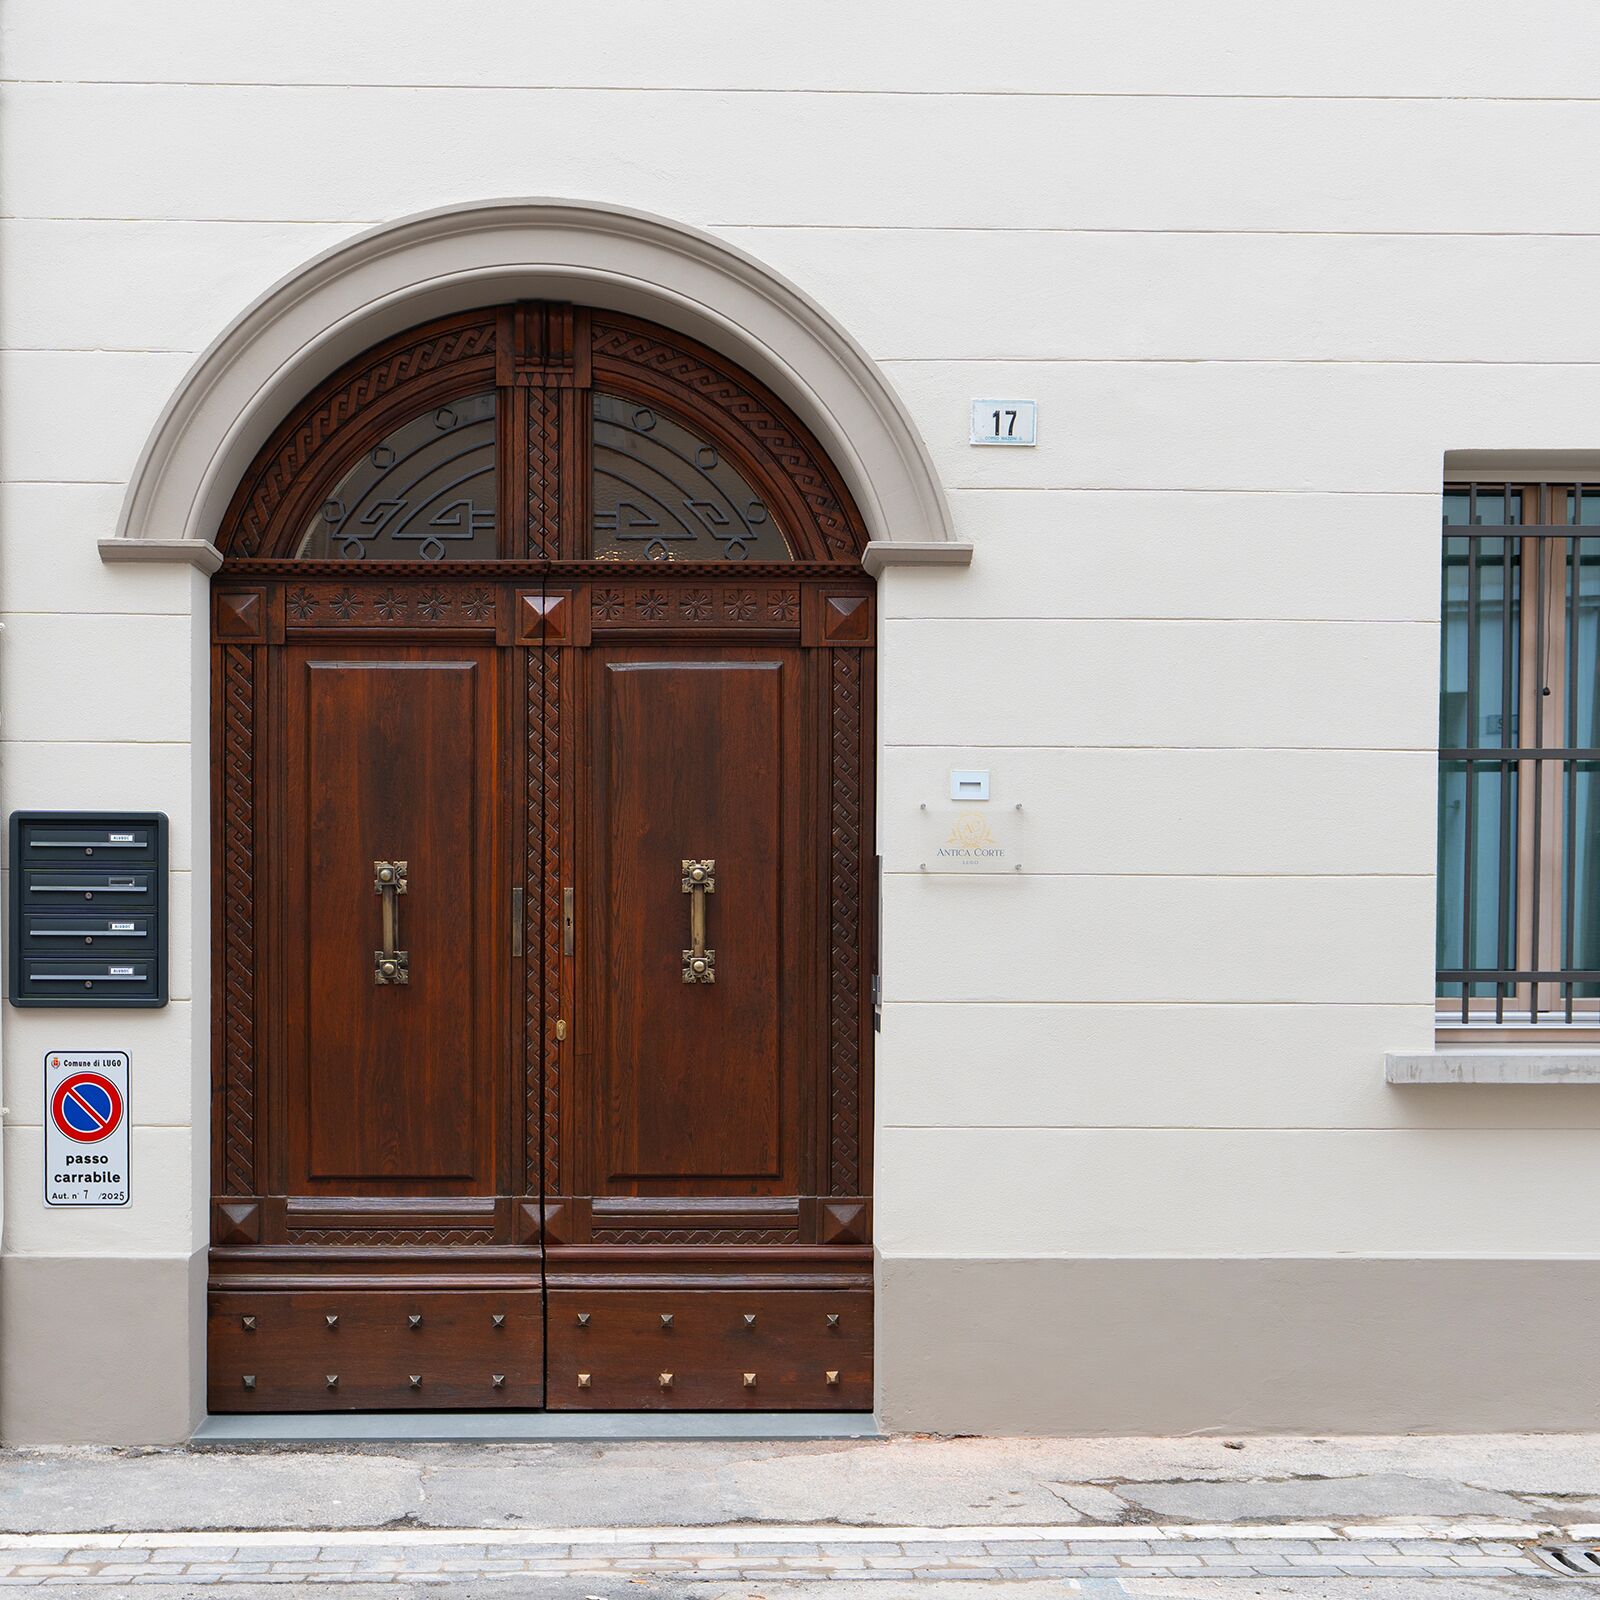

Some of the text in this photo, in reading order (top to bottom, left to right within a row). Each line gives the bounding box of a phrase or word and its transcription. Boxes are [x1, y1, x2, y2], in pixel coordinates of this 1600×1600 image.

[992, 410, 1017, 436] 17
[937, 848, 1005, 857] ANTICA CORTE
[64, 1059, 122, 1067] Comune di LUGO
[66, 1155, 109, 1166] passo
[54, 1171, 121, 1183] carrabile
[83, 1190, 89, 1199] 7
[98, 1192, 125, 1201] /2025
